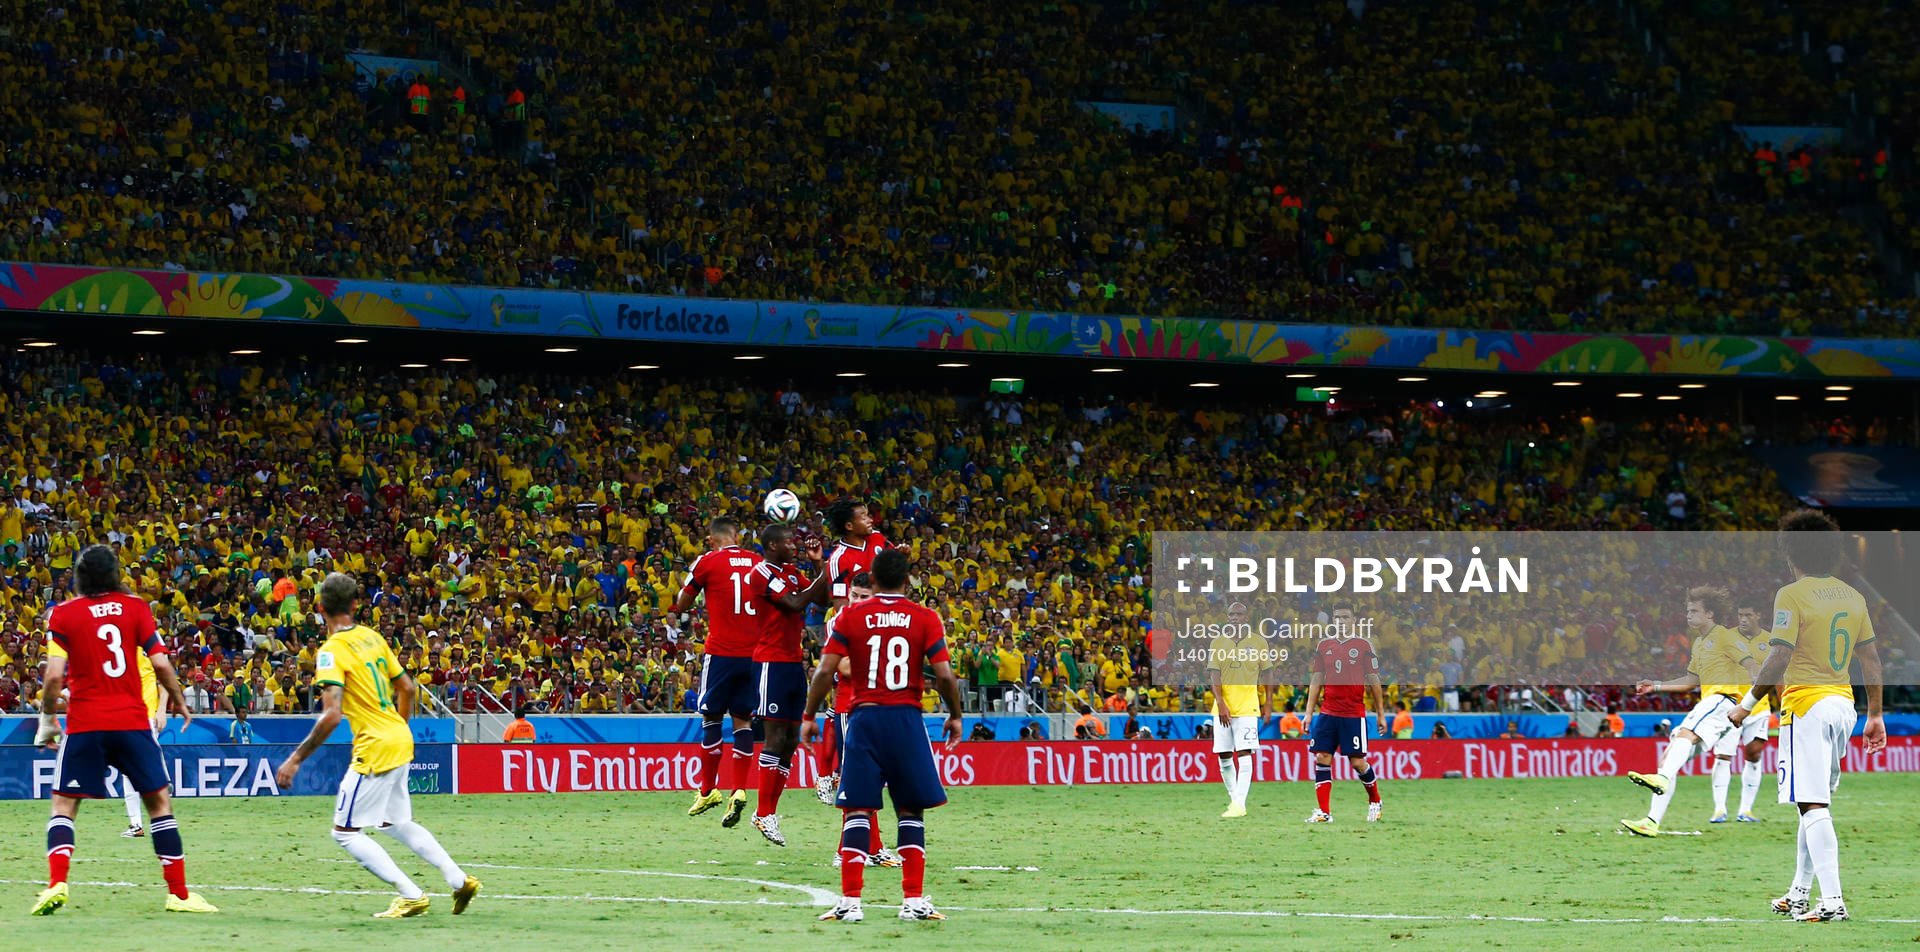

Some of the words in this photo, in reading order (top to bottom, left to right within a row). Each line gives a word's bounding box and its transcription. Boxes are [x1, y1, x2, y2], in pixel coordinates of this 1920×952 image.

[617, 303, 731, 335] Fortaleza
[88, 602, 123, 618] YEPES
[97, 623, 127, 678] 3
[1829, 611, 1850, 672] 6
[866, 634, 910, 691] 18
[1335, 659, 1343, 674] 9
[1352, 736, 1361, 750] 9
[1463, 743, 1506, 779] Fly
[1511, 741, 1618, 778] Emirates
[501, 749, 560, 793] Fly
[569, 746, 719, 791] Emirate
[1026, 746, 1075, 785] Fly
[1082, 743, 1208, 784] Emirates
[1255, 744, 1301, 782] Fly
